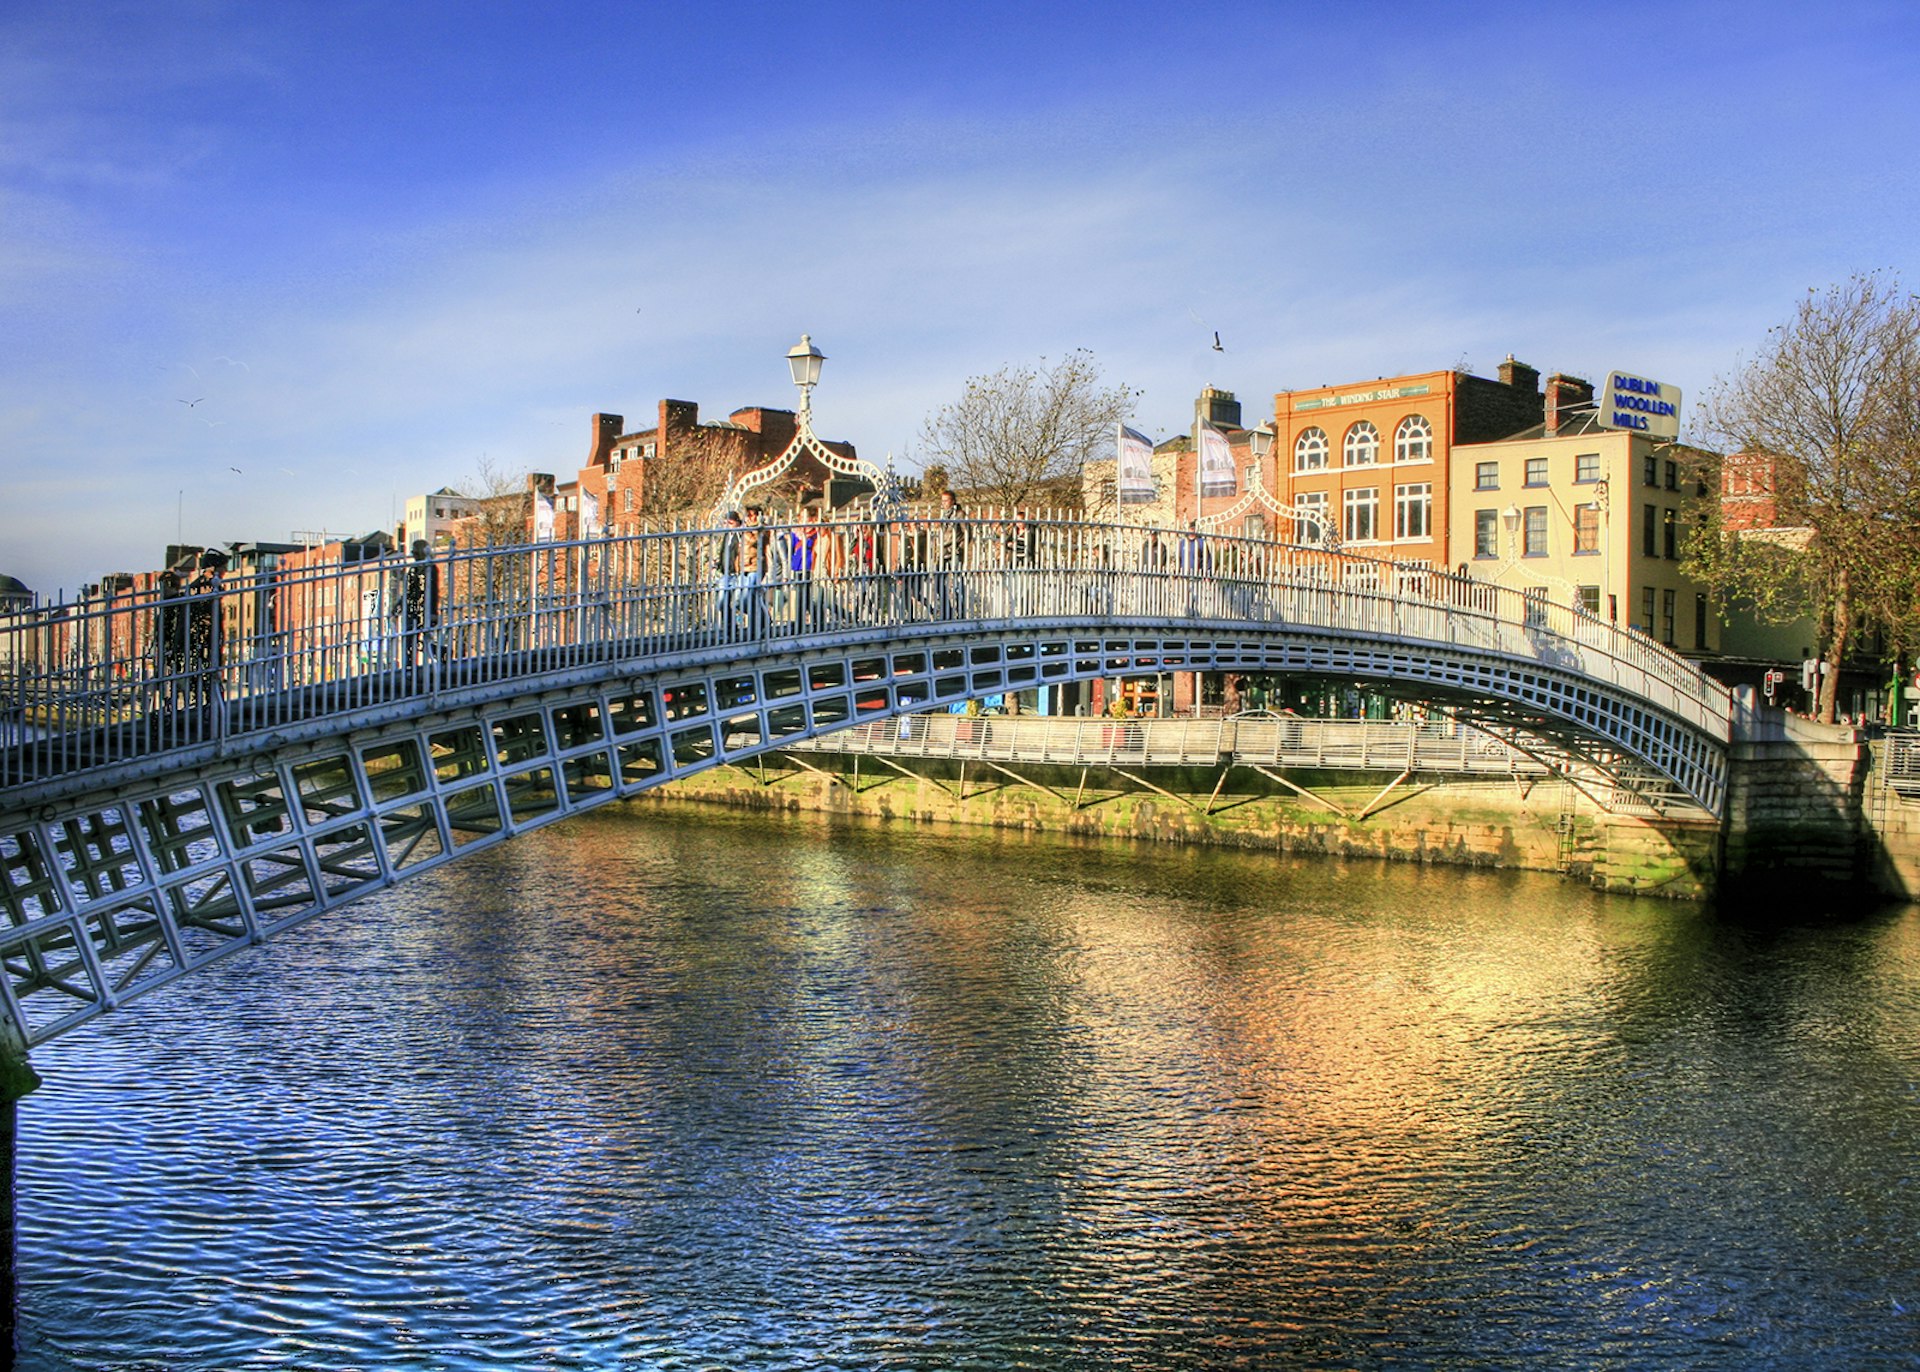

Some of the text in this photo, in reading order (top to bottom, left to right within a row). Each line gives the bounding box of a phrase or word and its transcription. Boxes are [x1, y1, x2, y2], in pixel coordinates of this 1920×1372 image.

[1613, 375, 1659, 396] DUBLIN
[1321, 388, 1400, 407] THE WINDING STAIR
[1613, 393, 1675, 416] WOOLLEN
[1612, 411, 1648, 430] MILLS
